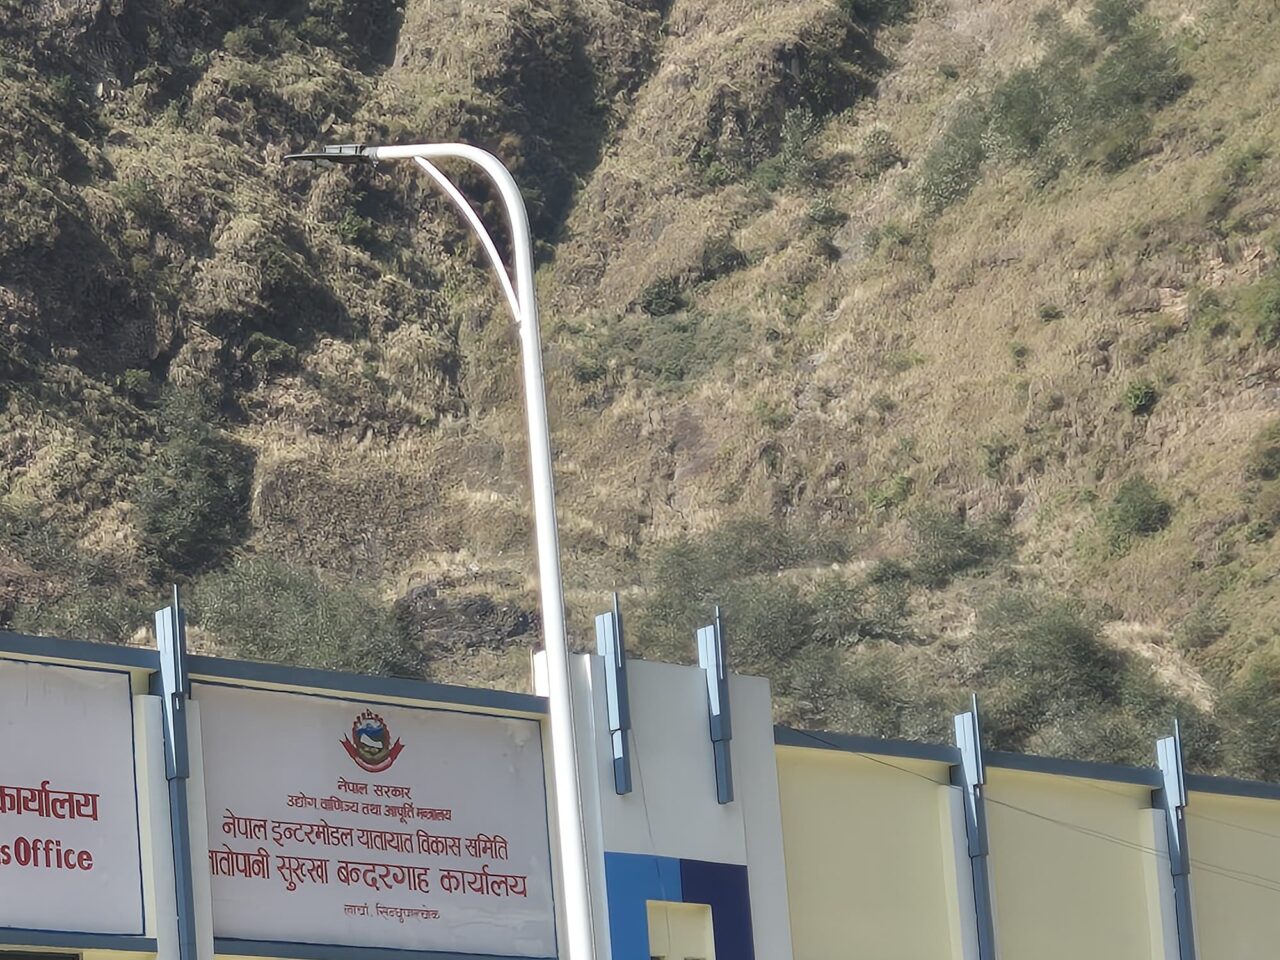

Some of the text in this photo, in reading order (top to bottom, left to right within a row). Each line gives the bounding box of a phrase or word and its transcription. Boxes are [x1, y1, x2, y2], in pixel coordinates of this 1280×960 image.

[337, 776, 412, 800] नेपाल सरकार
[320, 796, 359, 814] वाणिज्य
[362, 803, 382, 816] तथा
[222, 808, 509, 861] नेपाल इन्टरमोडल यातायात विकास समिति
[14, 836, 94, 871] Office
[338, 858, 430, 893] बन्दरगाह
[440, 864, 528, 898] कार्यालय
